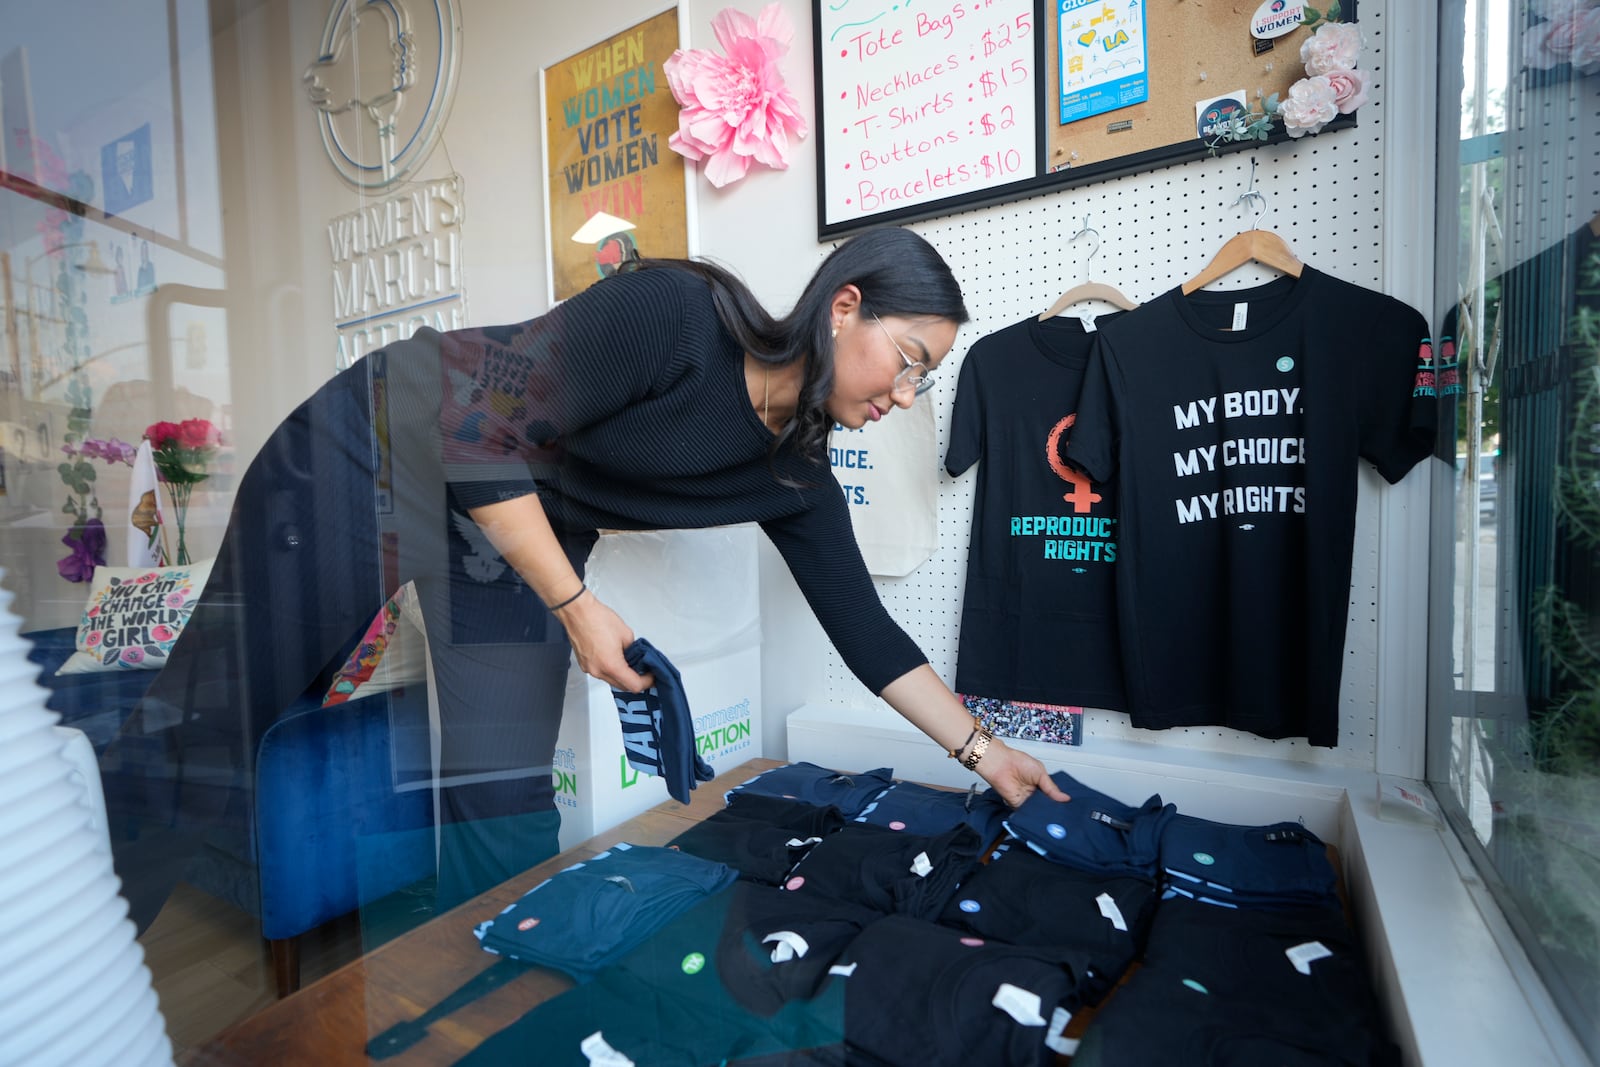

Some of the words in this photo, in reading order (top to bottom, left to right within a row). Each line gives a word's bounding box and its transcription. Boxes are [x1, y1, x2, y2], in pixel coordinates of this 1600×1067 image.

[849, 28, 903, 62] Tote
[916, 3, 965, 40] Bags
[1256, 13, 1302, 34] WOMEN
[1262, 6, 1301, 25] SUPPORT
[1102, 29, 1129, 52] LA
[571, 31, 645, 91] WHEN
[562, 61, 655, 129] WOMEN
[856, 55, 959, 110] Necklaces
[577, 103, 642, 155] VOTE
[563, 133, 658, 194] WOMEN
[860, 131, 959, 171] Buttons
[582, 175, 645, 219] WIN
[328, 179, 458, 262] WOMEN'S
[333, 232, 457, 319] MARCH
[1173, 397, 1217, 430] MY
[1223, 388, 1304, 418] BODY.
[1173, 445, 1218, 477] MY
[1175, 493, 1219, 524] MY
[1223, 486, 1306, 516] RIGHTS
[1010, 516, 1117, 537] REPRODUC
[1044, 539, 1117, 563] RIGHTS
[100, 593, 167, 615] CHANGE
[140, 580, 177, 594] CAN
[89, 614, 115, 631] THE
[102, 626, 155, 648] GIRL
[694, 697, 751, 734] onment
[695, 718, 751, 756] TATION
